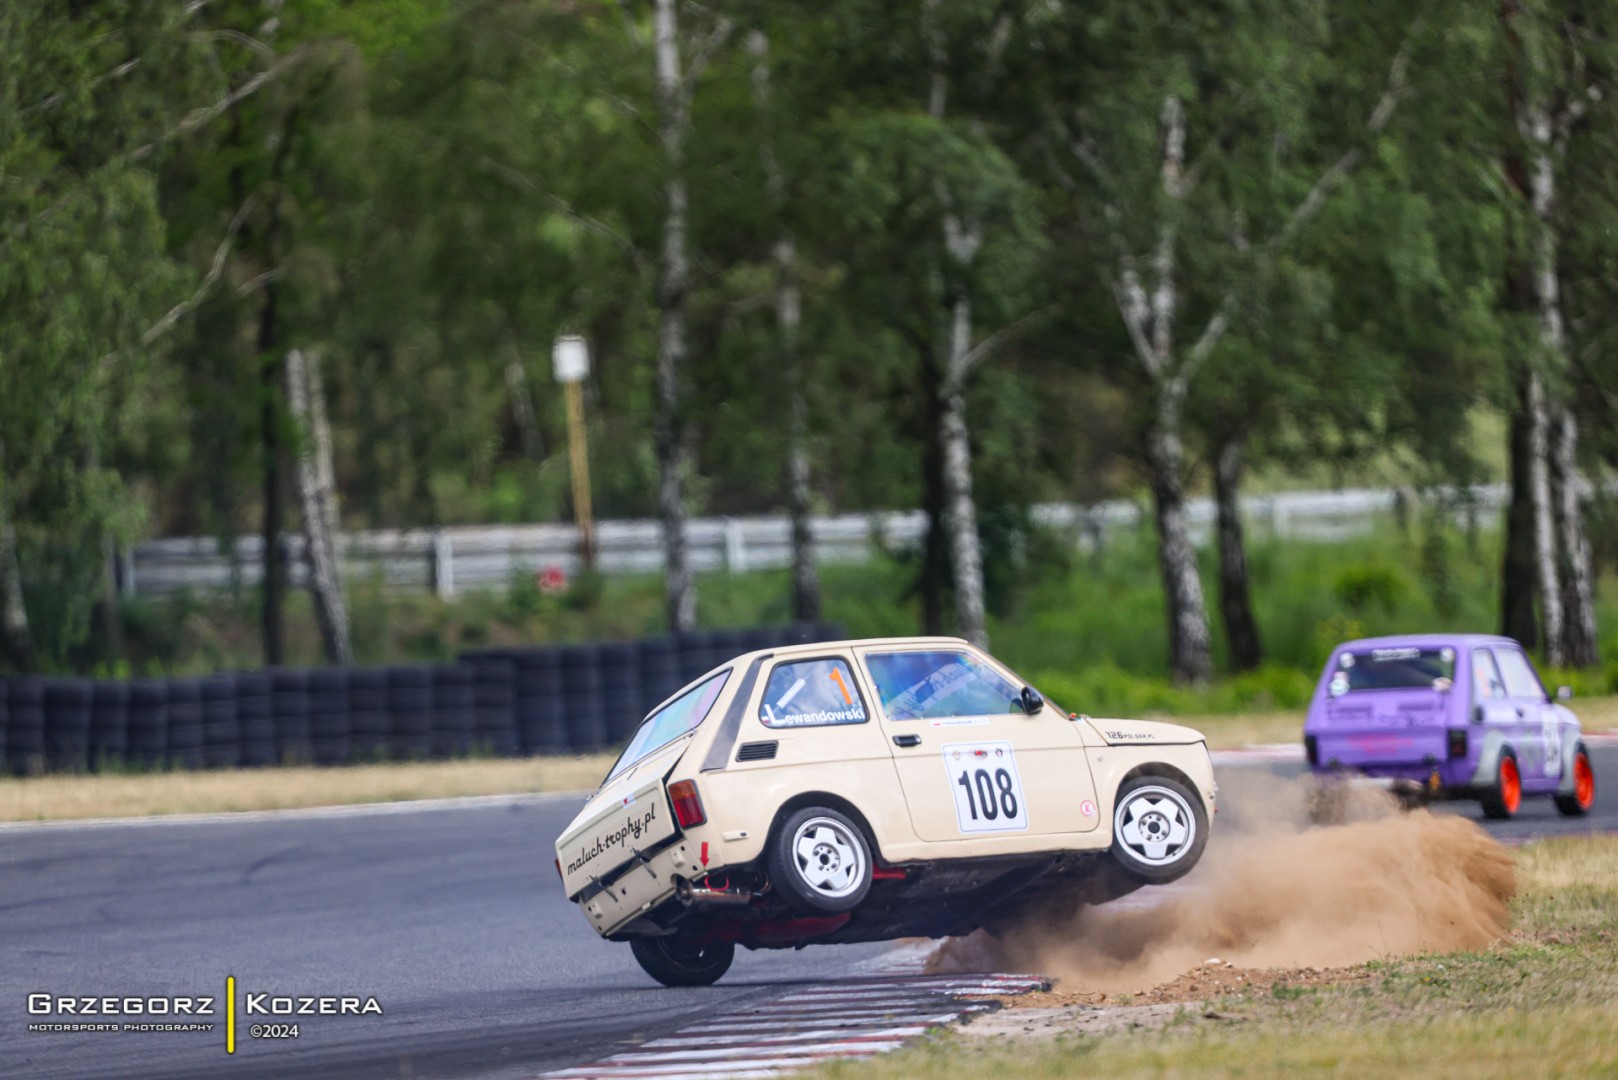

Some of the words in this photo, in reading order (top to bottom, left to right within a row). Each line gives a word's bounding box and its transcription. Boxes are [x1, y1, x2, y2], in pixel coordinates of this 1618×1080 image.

[764, 704, 866, 725] Lewandowski
[958, 767, 1018, 820] 108
[567, 802, 656, 876] maluch-trophy.pl
